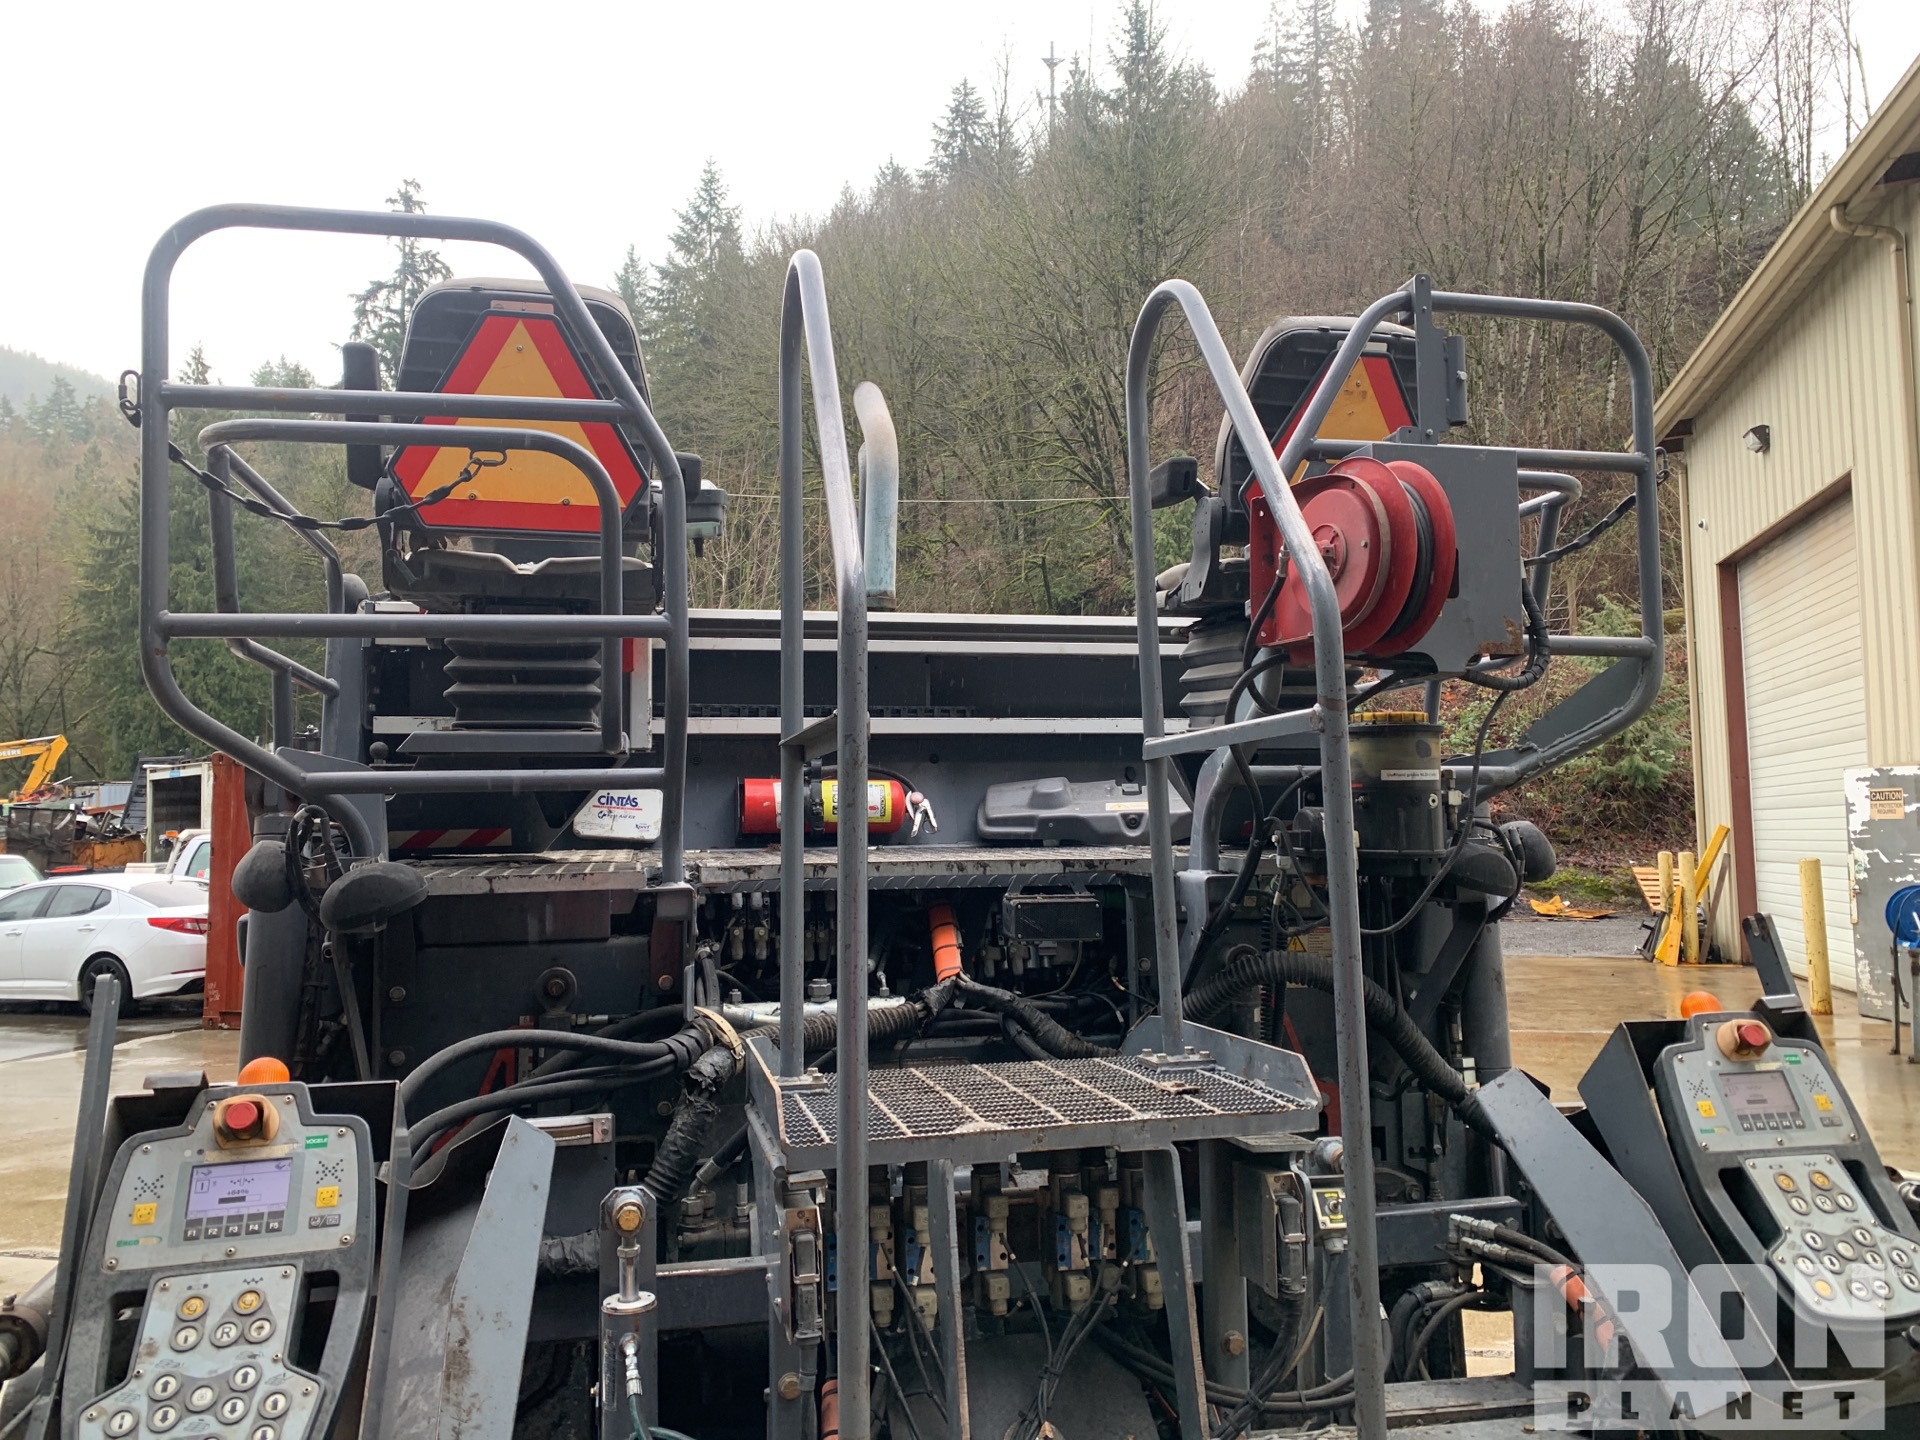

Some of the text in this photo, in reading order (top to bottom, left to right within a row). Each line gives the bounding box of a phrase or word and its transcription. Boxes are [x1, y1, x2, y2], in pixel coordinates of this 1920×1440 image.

[597, 792, 639, 808] CINTAS
[1871, 791, 1901, 800] CAUTION
[187, 1221, 279, 1238] F1 F2 F3 F4 F5
